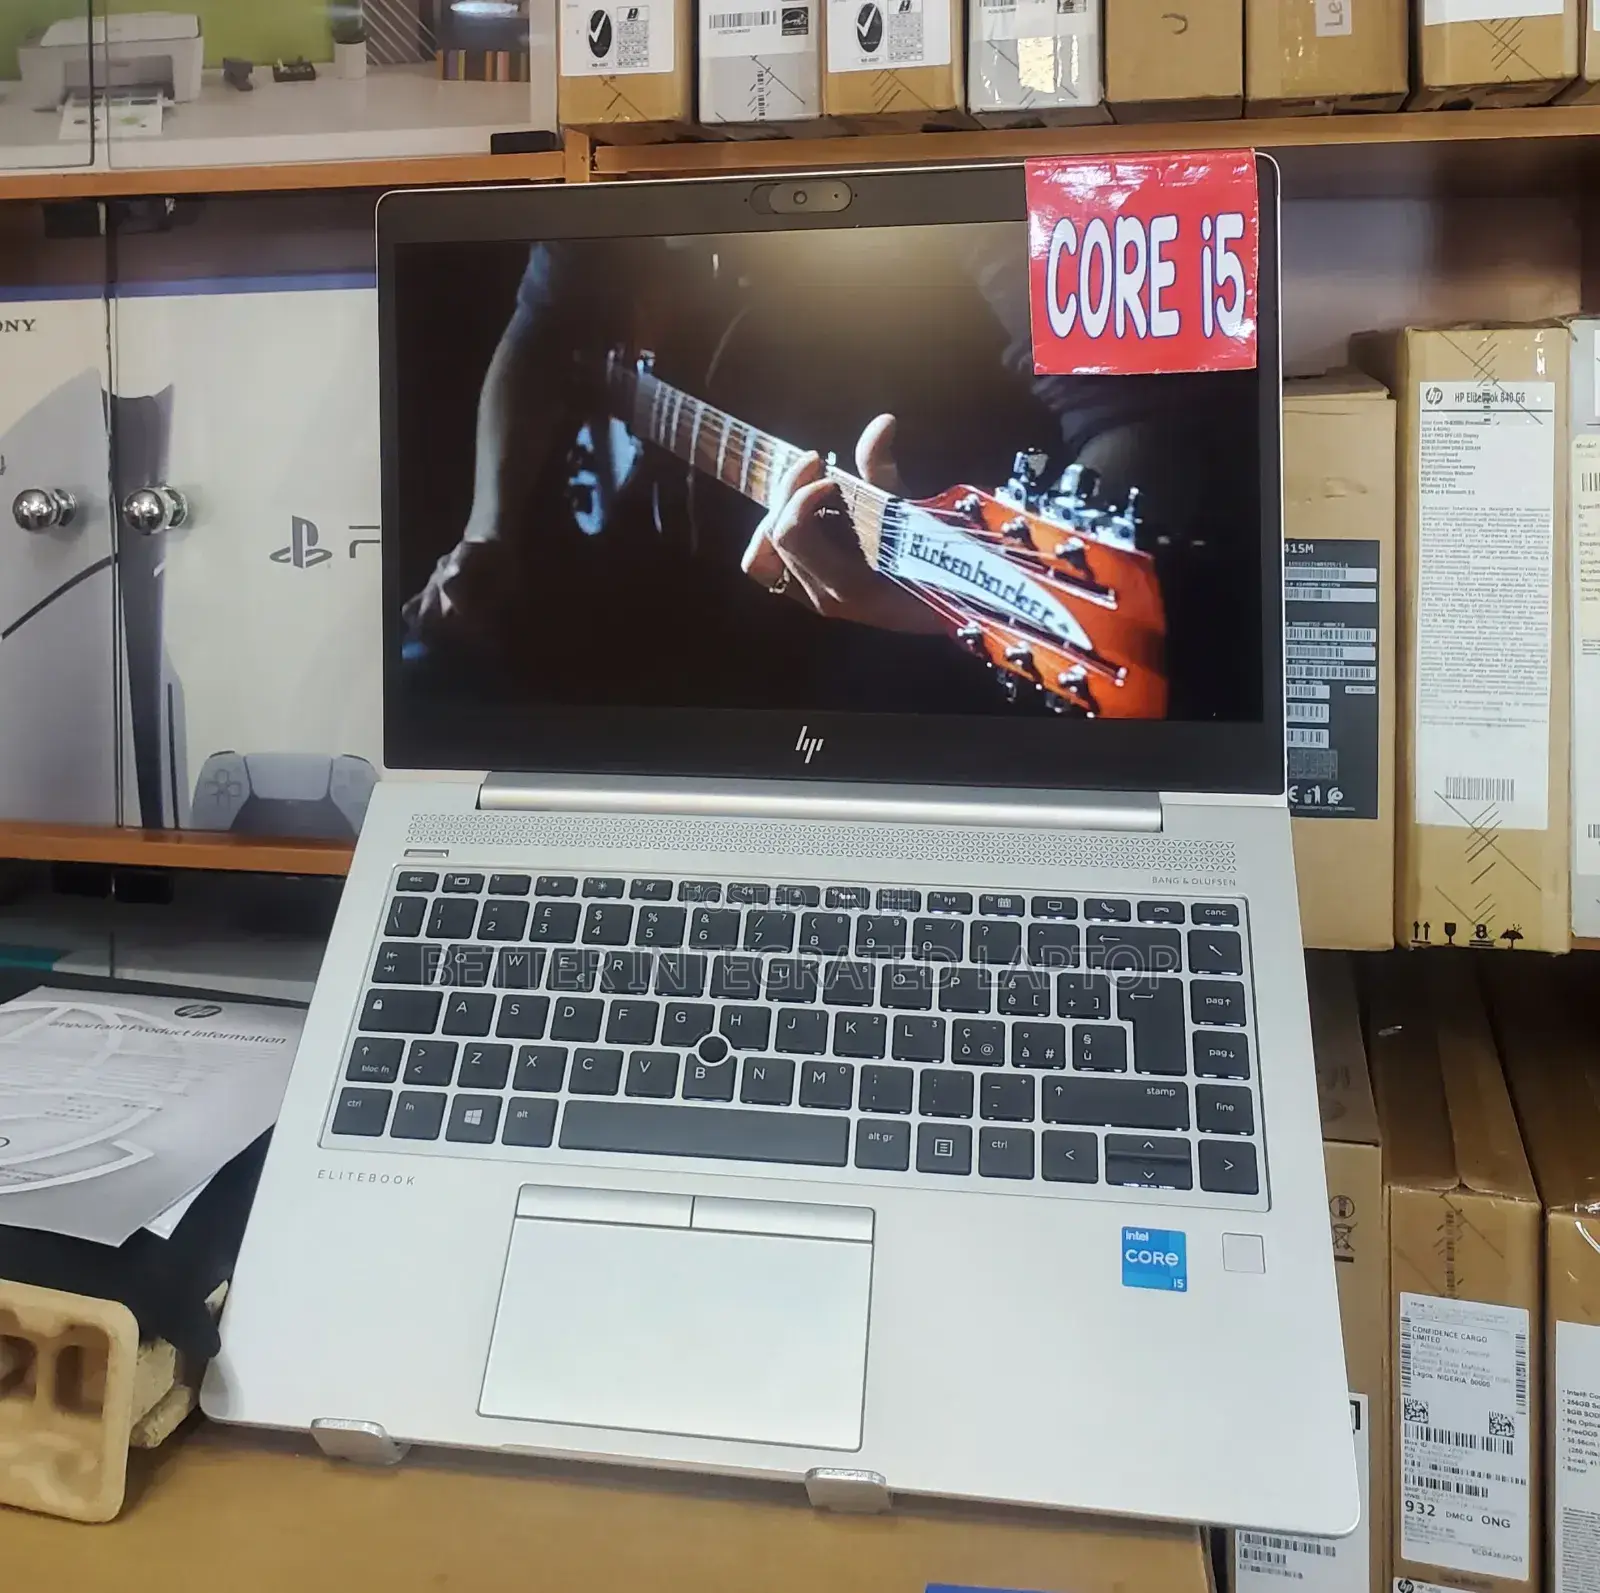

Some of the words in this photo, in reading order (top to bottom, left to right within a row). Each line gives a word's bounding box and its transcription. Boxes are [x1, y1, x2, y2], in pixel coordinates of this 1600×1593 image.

[1046, 214, 1181, 339] CORE
[1201, 212, 1246, 339] i5
[0, 319, 36, 332] NY
[1455, 392, 1465, 402] HP
[796, 726, 824, 763] hp
[1152, 876, 1179, 884] BANG
[544, 908, 551, 916] £
[595, 910, 602, 920] $
[648, 913, 657, 922] %
[701, 912, 711, 922] &
[487, 922, 495, 930] 2
[540, 924, 547, 933] 3
[592, 926, 600, 934] 4
[646, 929, 653, 937] 5
[700, 930, 707, 939] 6
[755, 933, 762, 942] 7
[808, 936, 818, 947] 8
[866, 939, 877, 948] 9
[508, 955, 524, 966] W
[613, 960, 623, 971] R
[779, 968, 789, 979] U
[951, 977, 960, 988] P
[456, 1002, 466, 1012] A
[511, 1004, 519, 1014] S
[564, 1006, 574, 1017] D
[619, 1009, 628, 1020] F
[676, 1012, 686, 1022] G
[731, 1015, 741, 1025] H
[788, 1018, 795, 1029] J
[846, 1022, 856, 1033] K
[129, 1024, 192, 1038] Product
[192, 1029, 287, 1045] Information
[905, 1025, 913, 1036] L
[981, 1044, 993, 1055] @
[1046, 1049, 1054, 1058] #
[472, 1053, 482, 1064] Z
[527, 1055, 537, 1066] X
[583, 1058, 593, 1069] C
[640, 1061, 650, 1072] V
[695, 1067, 705, 1078] B
[754, 1068, 765, 1079] N
[813, 1072, 825, 1083] M
[1147, 1088, 1175, 1096] stamp
[1217, 1103, 1234, 1111] fine
[317, 1169, 416, 1186] ELITEBOOK
[1412, 1325, 1458, 1339] CONFIDENCE
[1461, 1334, 1488, 1343] CARGO
[1412, 1334, 1441, 1344] LIMITED
[1405, 1500, 1436, 1517] 932
[1481, 1515, 1511, 1529] ONG
